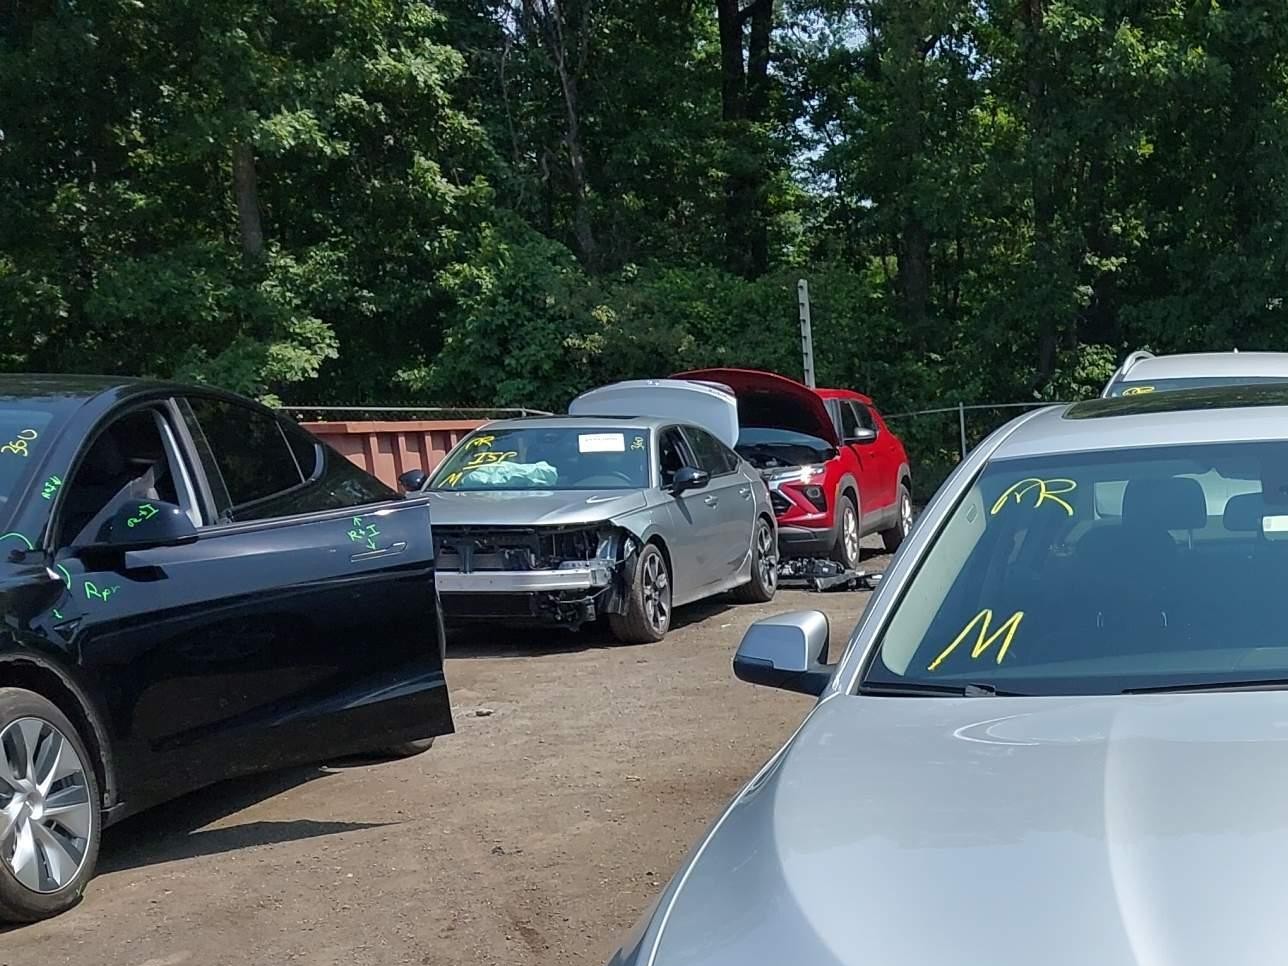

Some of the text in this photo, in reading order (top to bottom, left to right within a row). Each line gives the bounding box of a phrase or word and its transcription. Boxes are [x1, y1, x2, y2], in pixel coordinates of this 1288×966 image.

[1, 429, 38, 457] 360
[437, 472, 464, 488] M
[927, 608, 1024, 671] M
